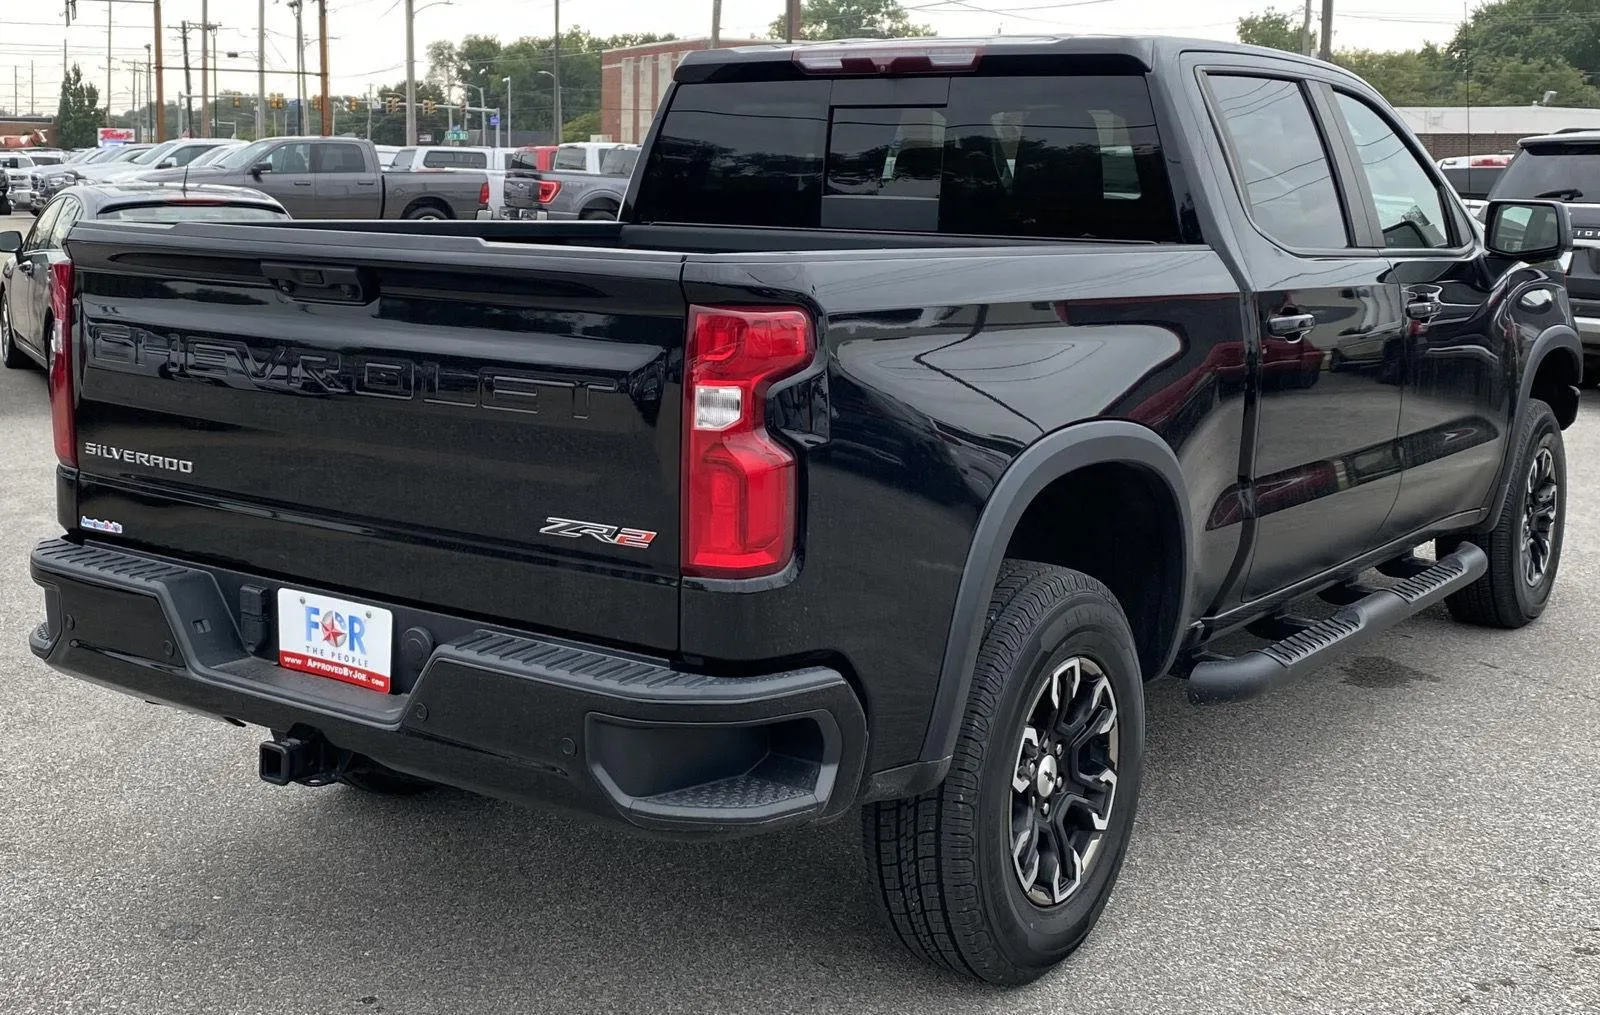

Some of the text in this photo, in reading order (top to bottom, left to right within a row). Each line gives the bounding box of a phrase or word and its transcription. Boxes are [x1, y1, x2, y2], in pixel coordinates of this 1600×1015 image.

[91, 325, 618, 419] CHEVROLET
[85, 442, 193, 474] SILVERADO
[539, 517, 657, 548] ZR2
[305, 606, 367, 655] FOR
[305, 645, 368, 668] THE PEOPLE
